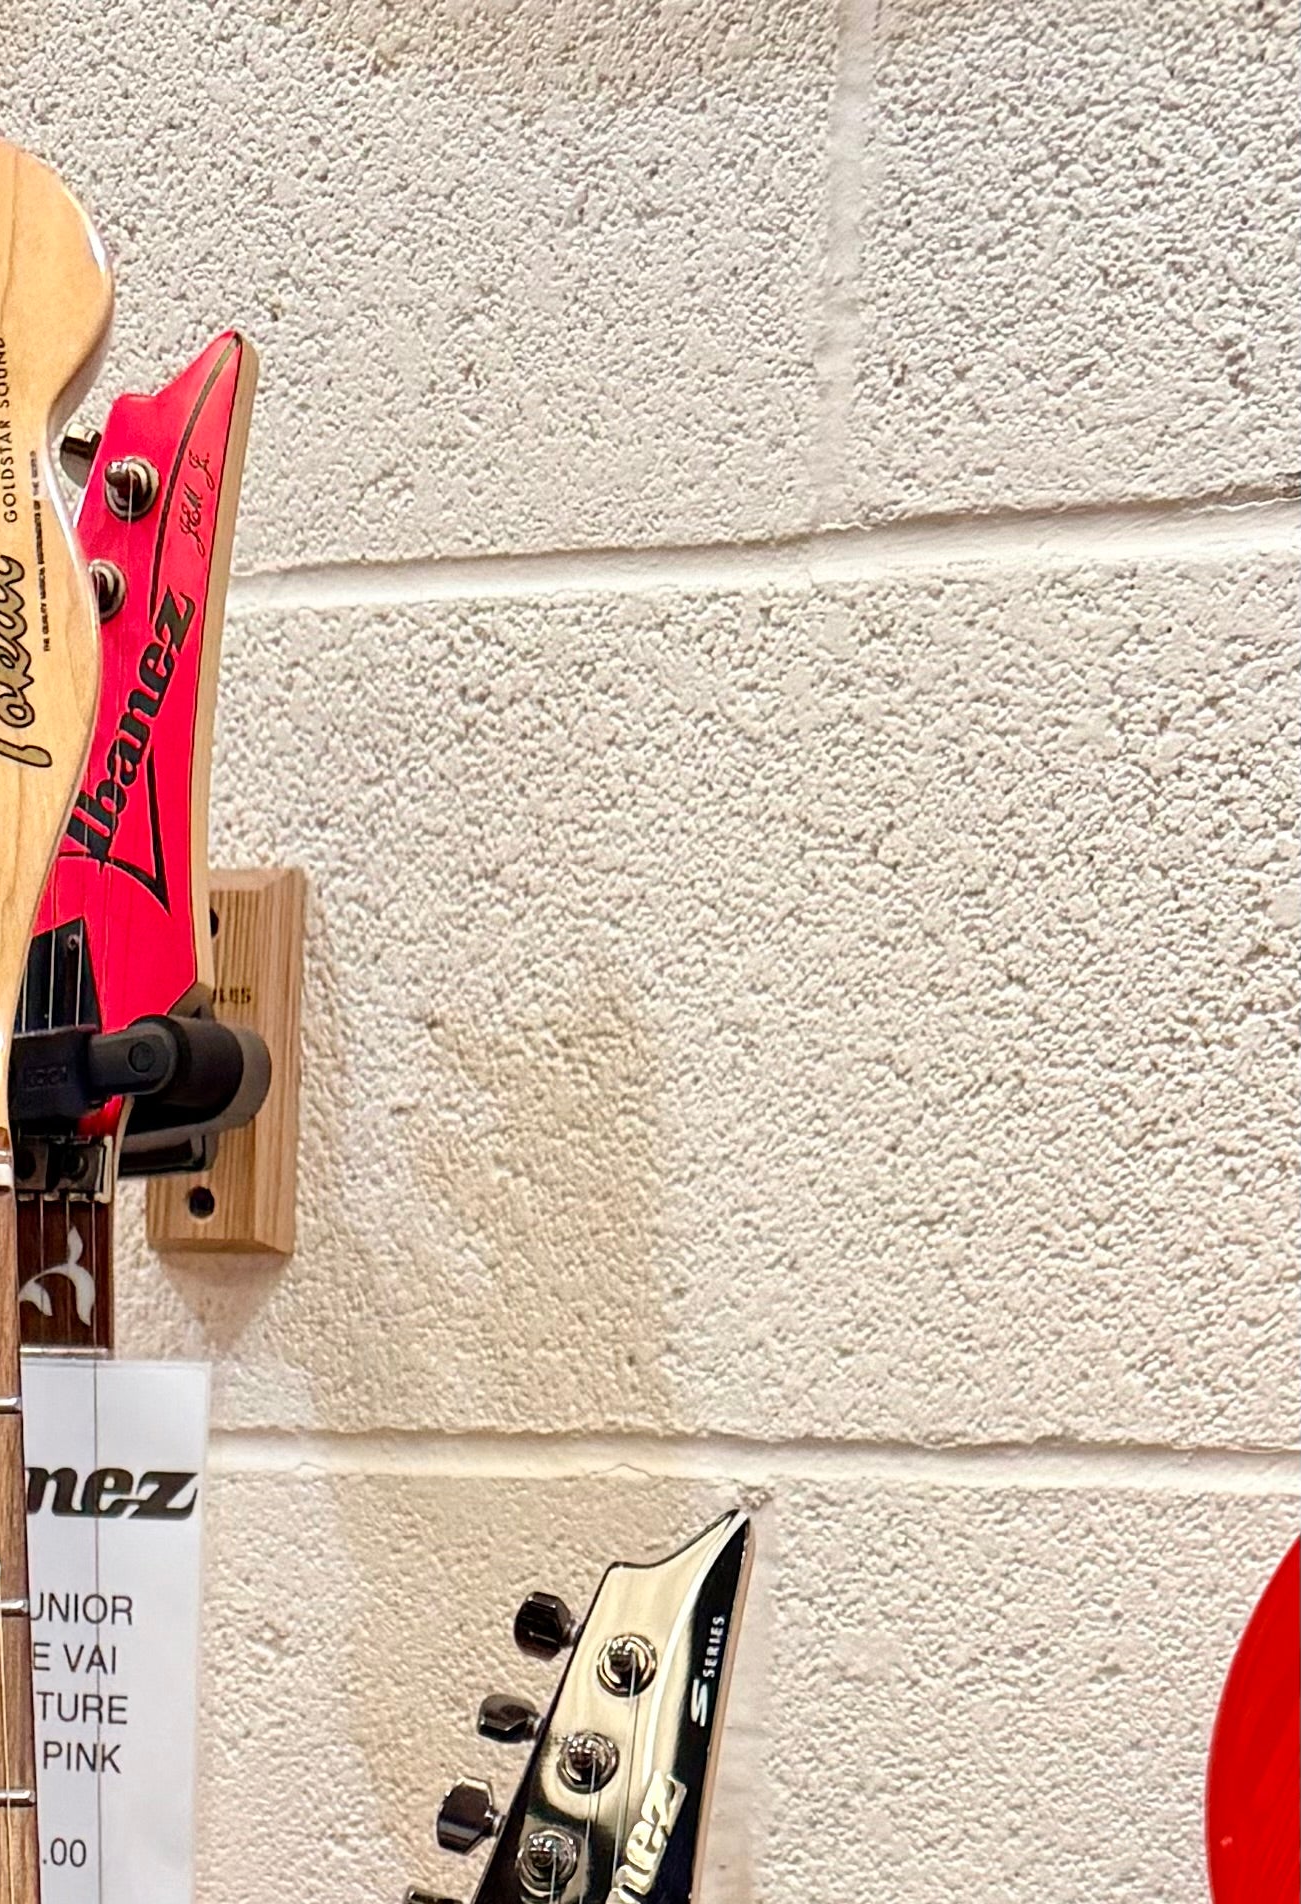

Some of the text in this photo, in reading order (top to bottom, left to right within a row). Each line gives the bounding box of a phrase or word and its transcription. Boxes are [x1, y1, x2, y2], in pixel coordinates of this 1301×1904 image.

[66, 584, 196, 874] Ibanez
[63, 1643, 117, 1675] VAI
[702, 1615, 726, 1679] SERIES
[36, 1691, 128, 1725] TURE
[43, 1741, 122, 1775] PINK
[42, 1837, 87, 1868] .00
